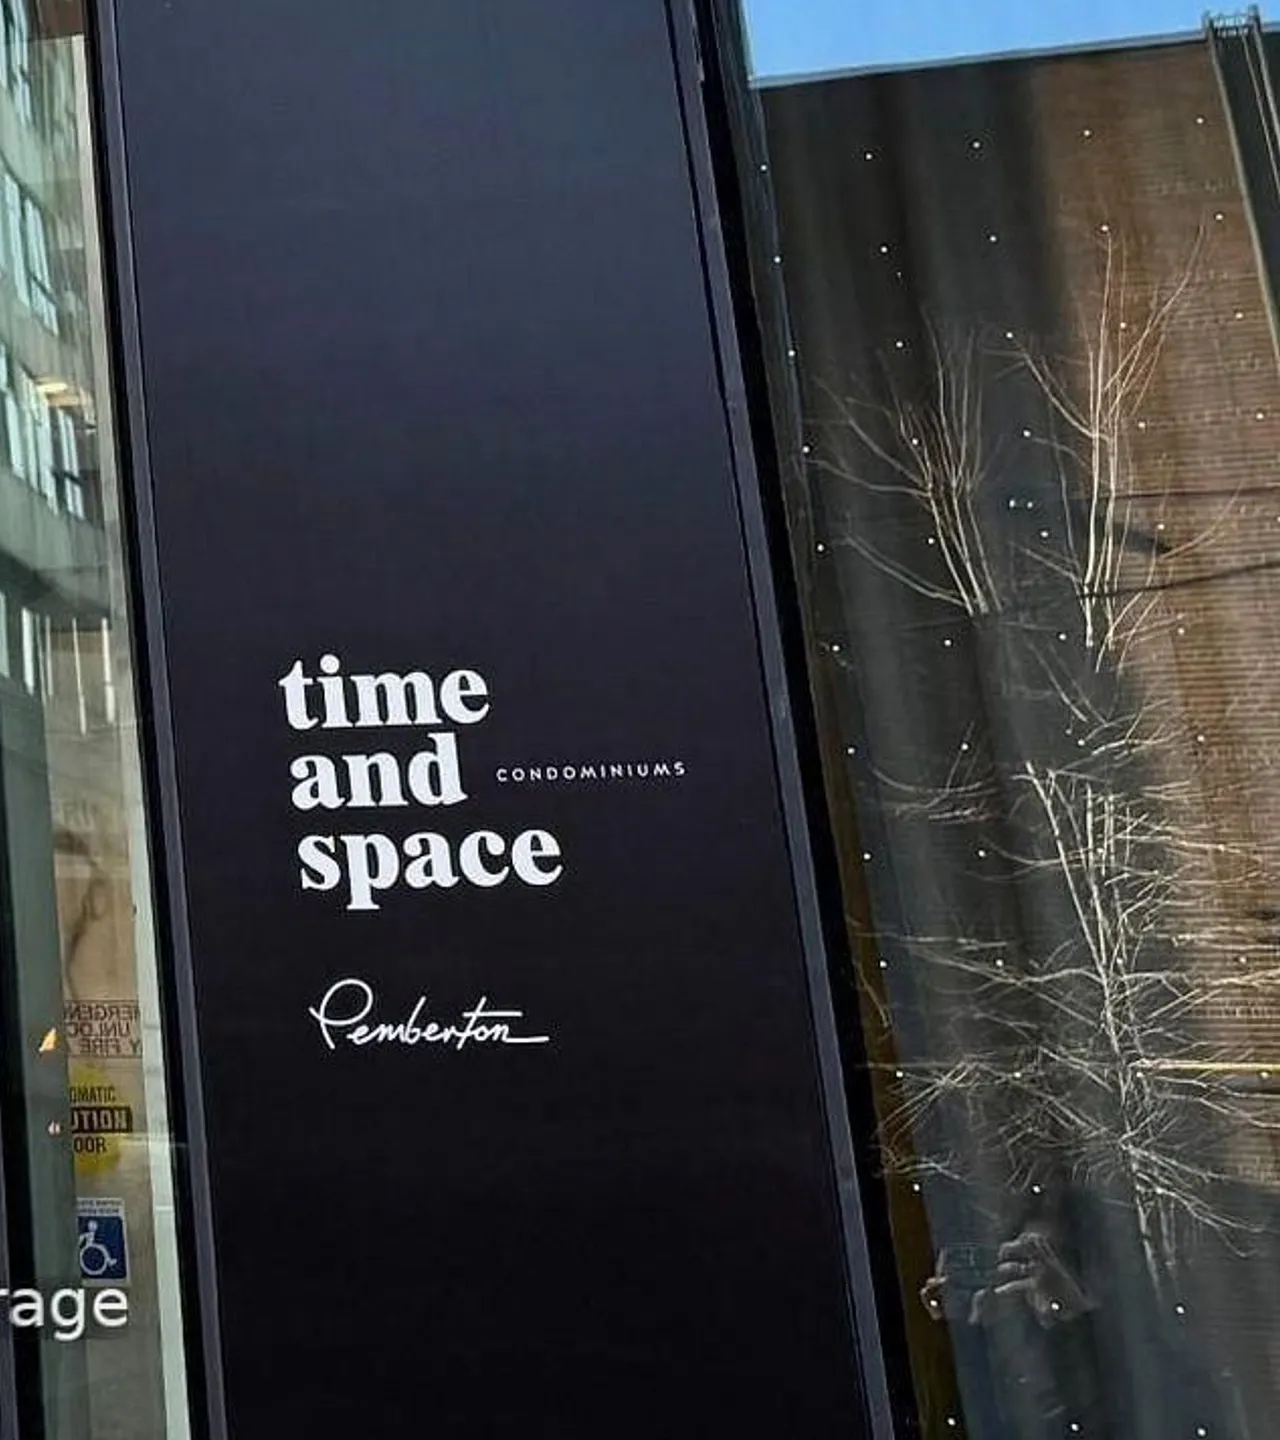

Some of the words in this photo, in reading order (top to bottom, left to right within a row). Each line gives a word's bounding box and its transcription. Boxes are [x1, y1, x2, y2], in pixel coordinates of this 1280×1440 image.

[278, 653, 491, 731] time
[289, 731, 469, 811] and
[495, 761, 686, 783] CONDOMINIUMS
[297, 827, 564, 911] space
[308, 978, 550, 1051] Pemberton
